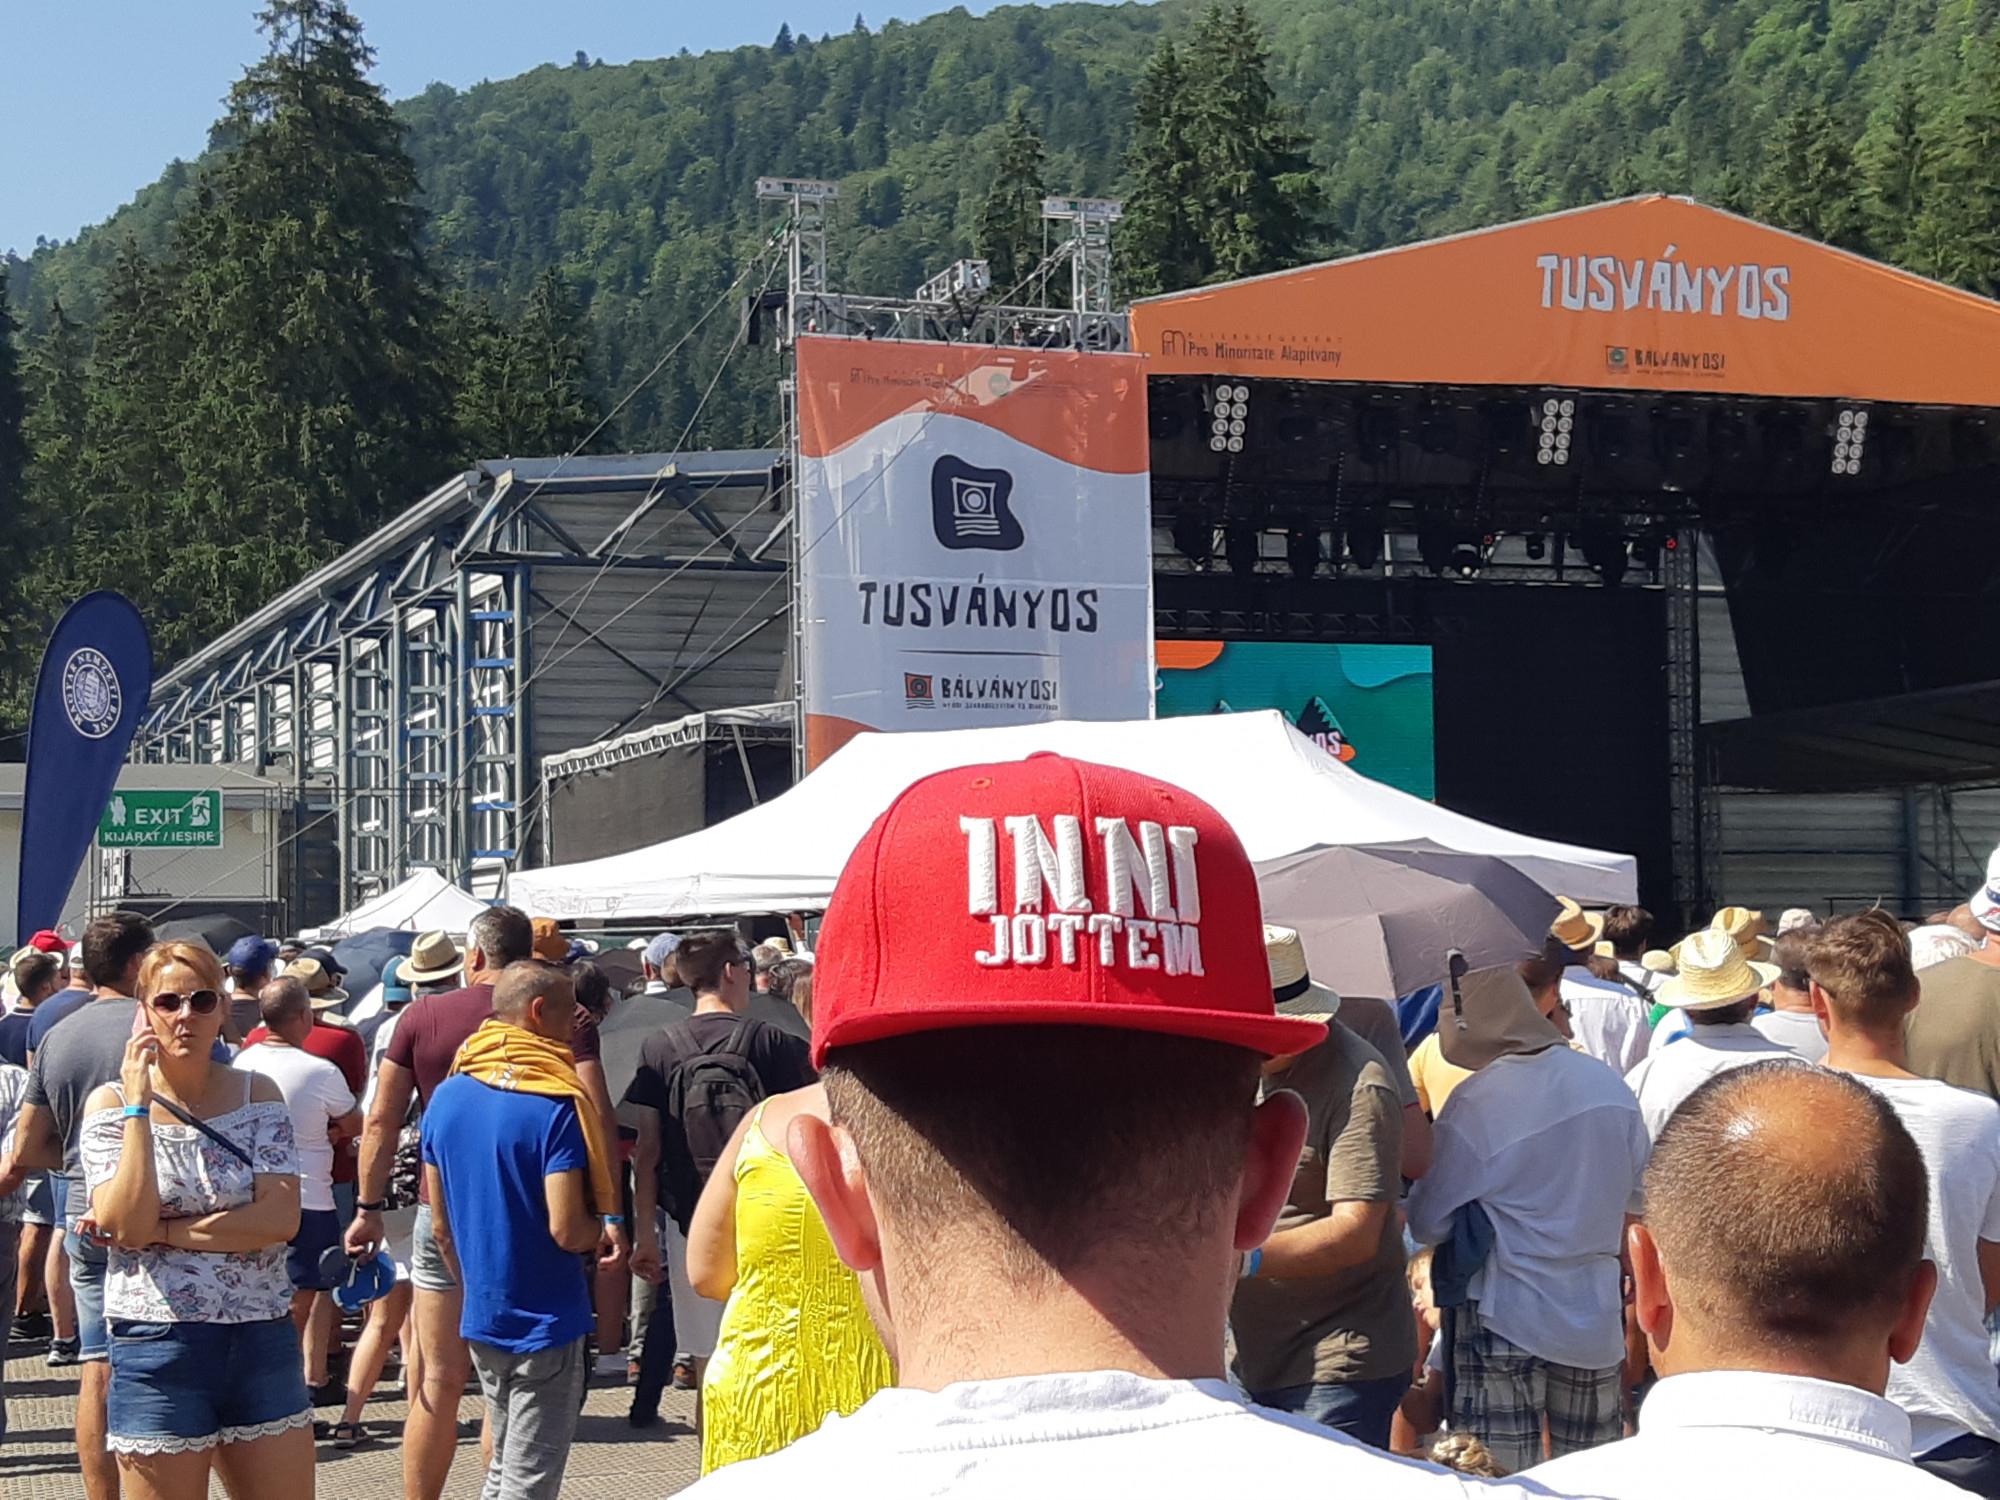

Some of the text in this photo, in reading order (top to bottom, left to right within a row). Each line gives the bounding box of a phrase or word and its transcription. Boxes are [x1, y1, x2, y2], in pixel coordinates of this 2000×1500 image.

[1536, 243, 1790, 321] TUSVÁNYOS
[858, 573, 1099, 633] TUSVÁNYOS
[941, 673, 1058, 701] BÁLVÁNYOSI
[104, 829, 160, 842] KIJÁRAT
[134, 808, 184, 825] EXIT
[959, 814, 1200, 924] INNI
